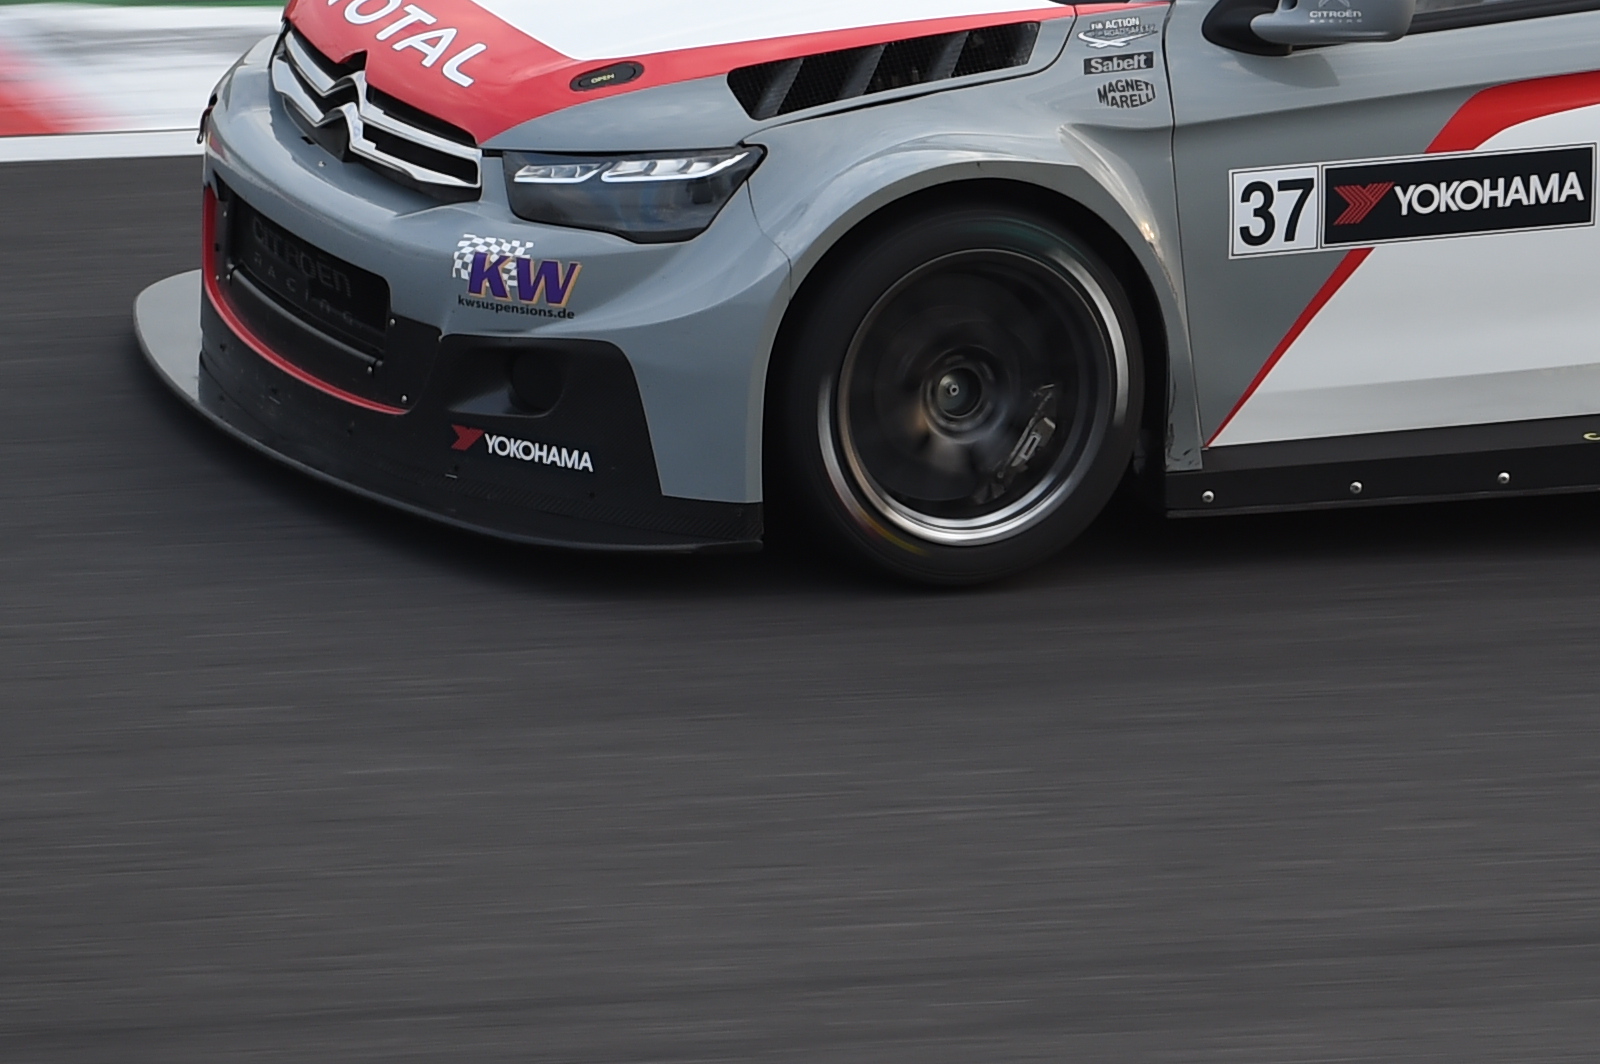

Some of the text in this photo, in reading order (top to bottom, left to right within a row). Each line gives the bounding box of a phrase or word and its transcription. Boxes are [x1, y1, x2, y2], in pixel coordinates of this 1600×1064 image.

[1105, 17, 1140, 29] ACTION
[1090, 54, 1147, 73] Sabelt
[1239, 178, 1315, 247] 37
[1394, 171, 1585, 216] YOKOHAMA
[467, 251, 582, 308] KW
[458, 294, 575, 319] kwsuspensions.de
[484, 433, 594, 473] YOKOHAMA
